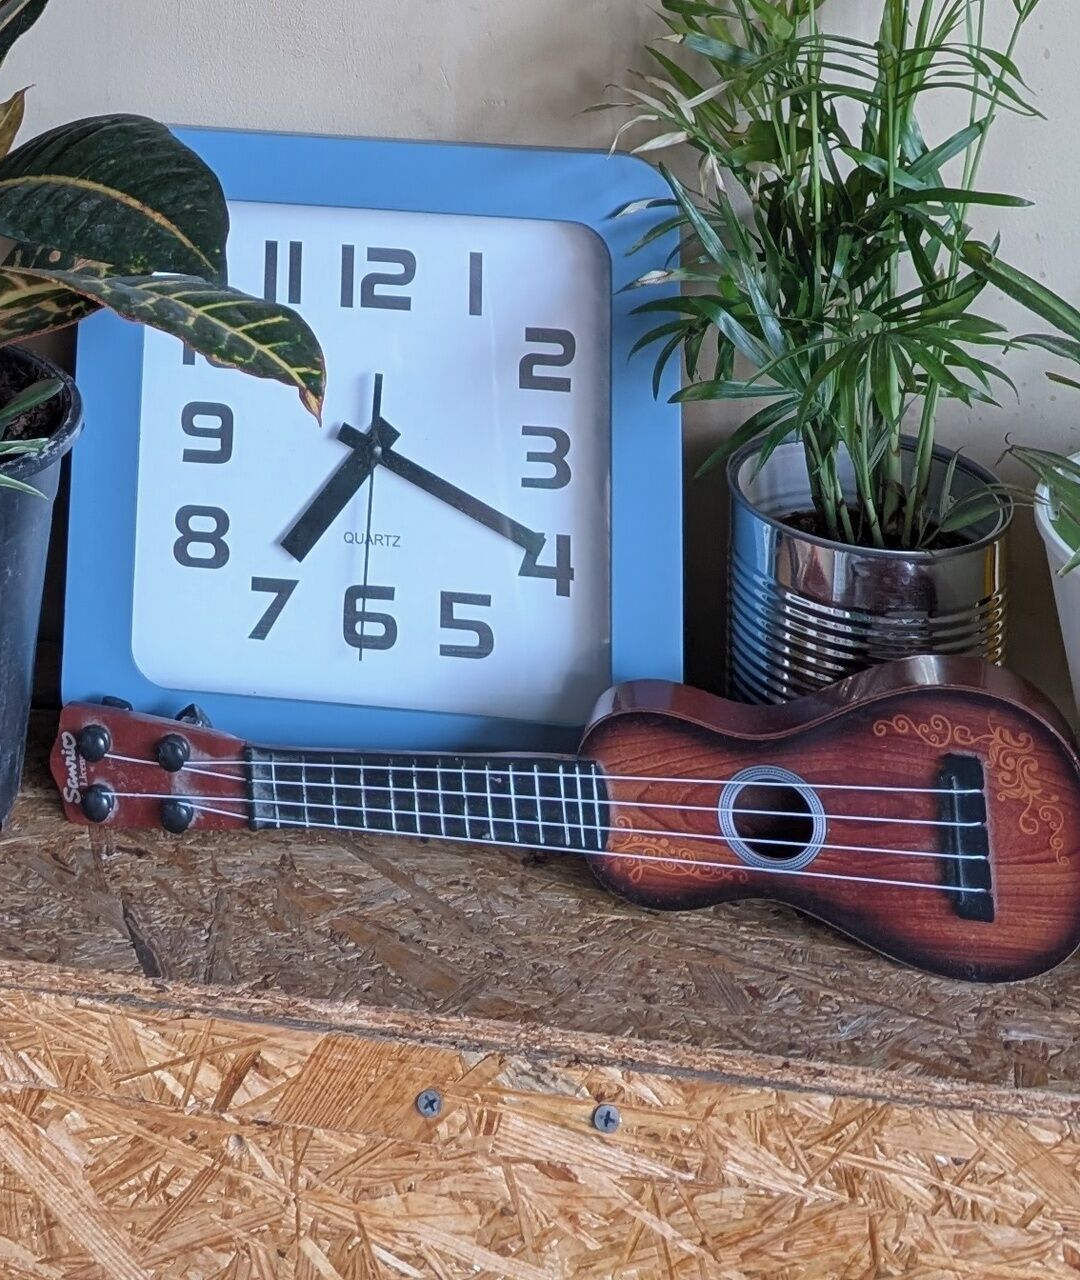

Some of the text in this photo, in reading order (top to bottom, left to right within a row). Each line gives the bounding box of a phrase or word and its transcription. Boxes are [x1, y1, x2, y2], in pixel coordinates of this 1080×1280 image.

[264, 240, 303, 305] 11
[340, 244, 417, 311] 12
[469, 252, 483, 316] 1
[518, 327, 577, 393] 2
[180, 401, 234, 465] 9
[520, 425, 572, 490] 3
[172, 504, 231, 570] 8
[343, 531, 401, 548] QUARTZ
[518, 532, 575, 598] 4
[248, 576, 300, 641] 7
[342, 585, 398, 651] 6
[439, 590, 495, 660] 5
